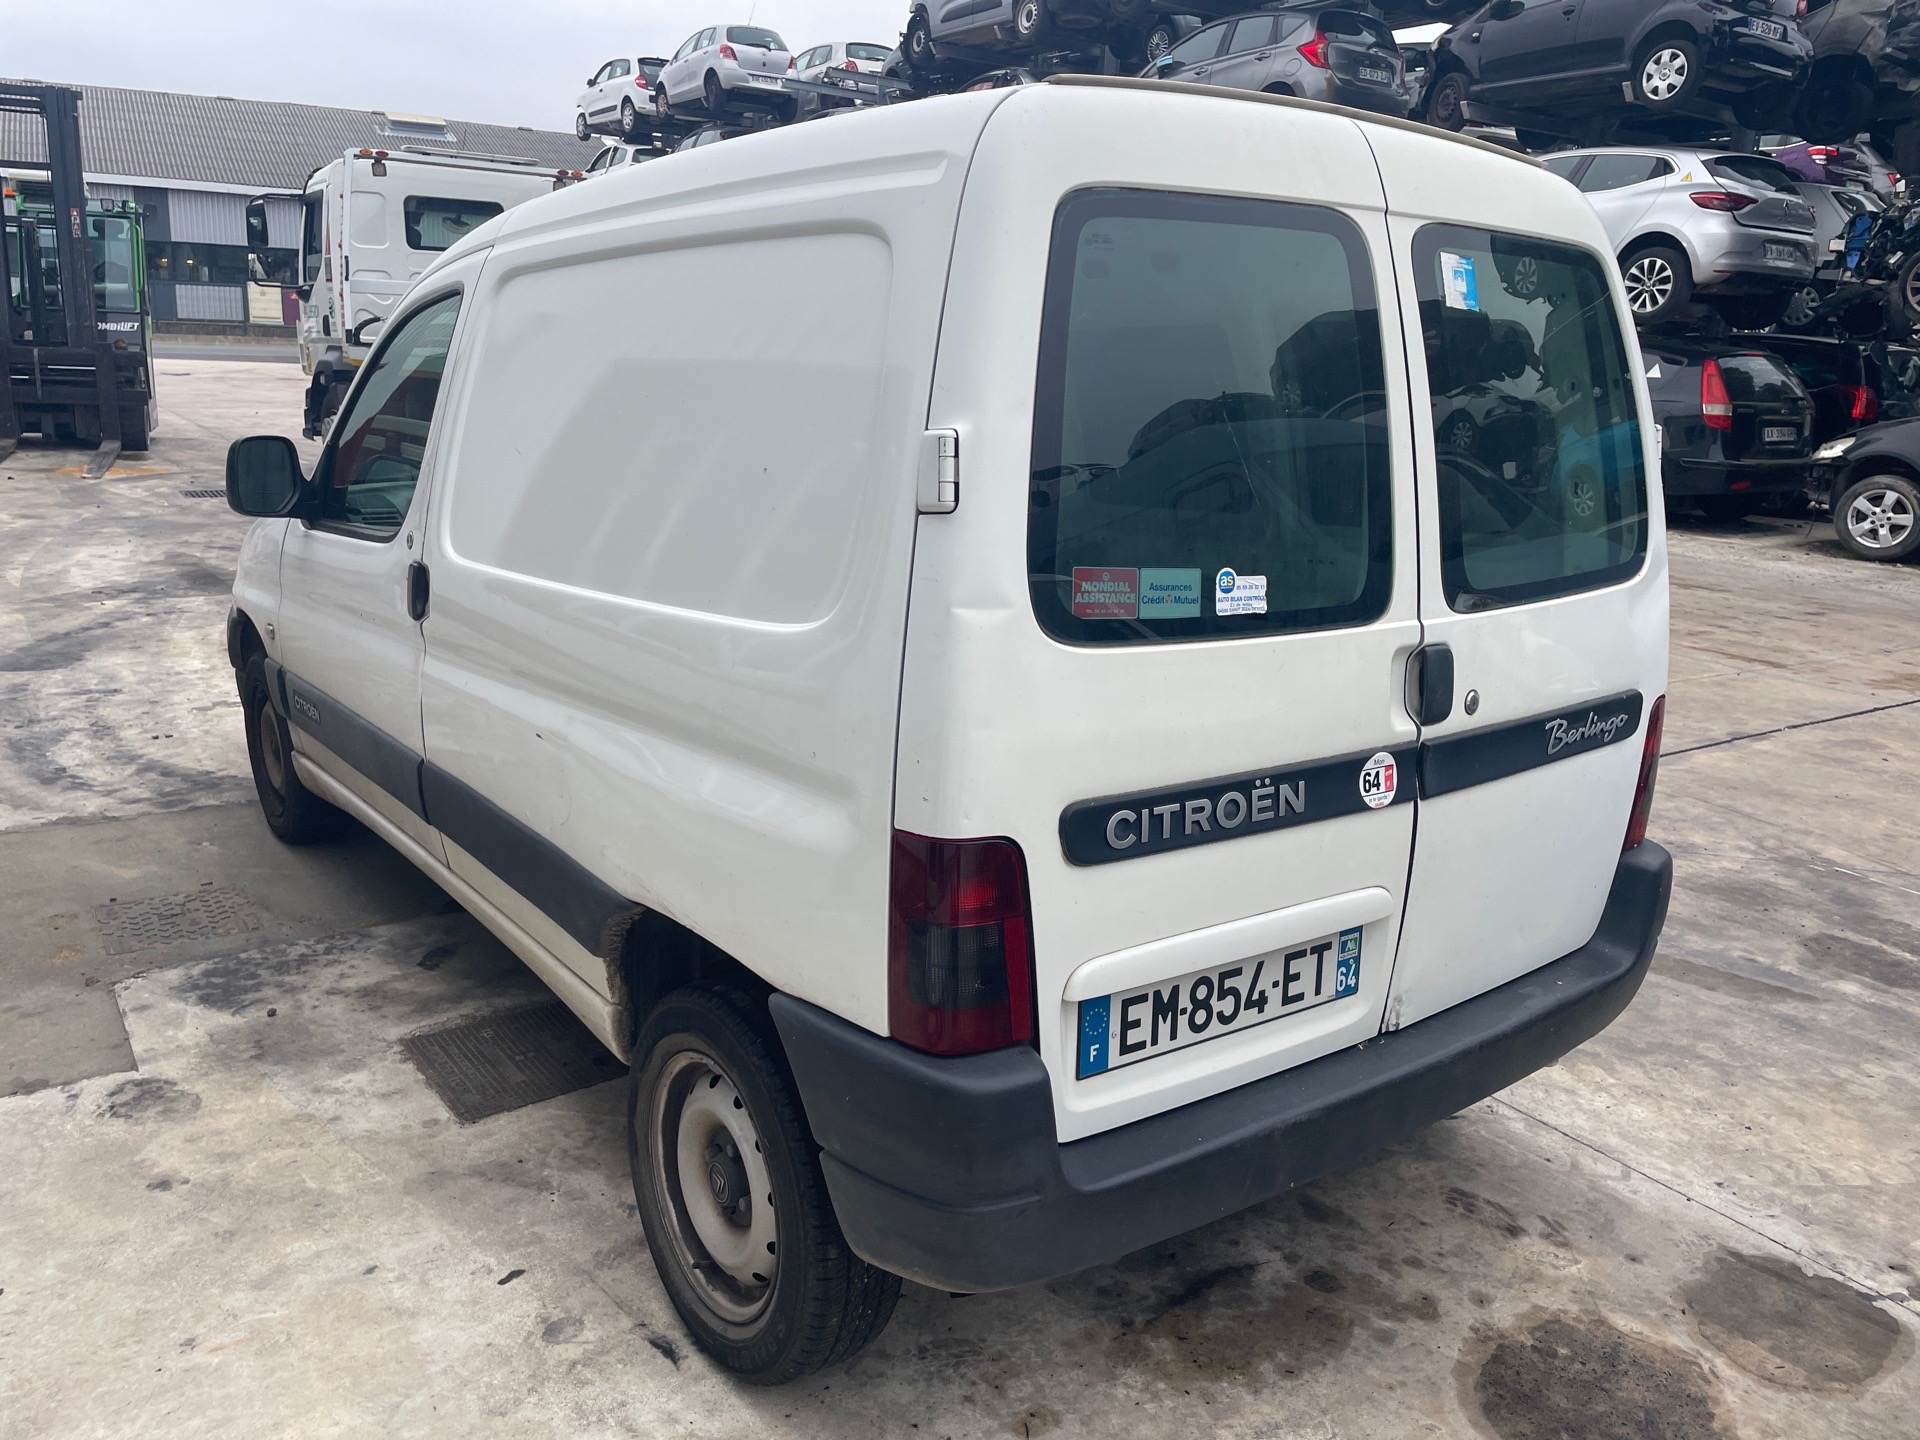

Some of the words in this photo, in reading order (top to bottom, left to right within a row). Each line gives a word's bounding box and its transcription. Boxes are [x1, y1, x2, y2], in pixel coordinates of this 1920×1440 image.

[1081, 581, 1131, 592] MONDIAL
[1149, 582, 1193, 592] Assurances
[1075, 593, 1136, 604] ASSISTANCE
[1141, 595, 1165, 604] Crédit
[1173, 595, 1199, 604] Mutuel
[1545, 711, 1628, 755] Berlingo
[1363, 770, 1381, 793] 64
[1106, 777, 1305, 849] CITROËN
[1337, 963, 1357, 991] 64
[1119, 941, 1333, 1057] EM-854-ET
[1089, 1043, 1100, 1063] F
